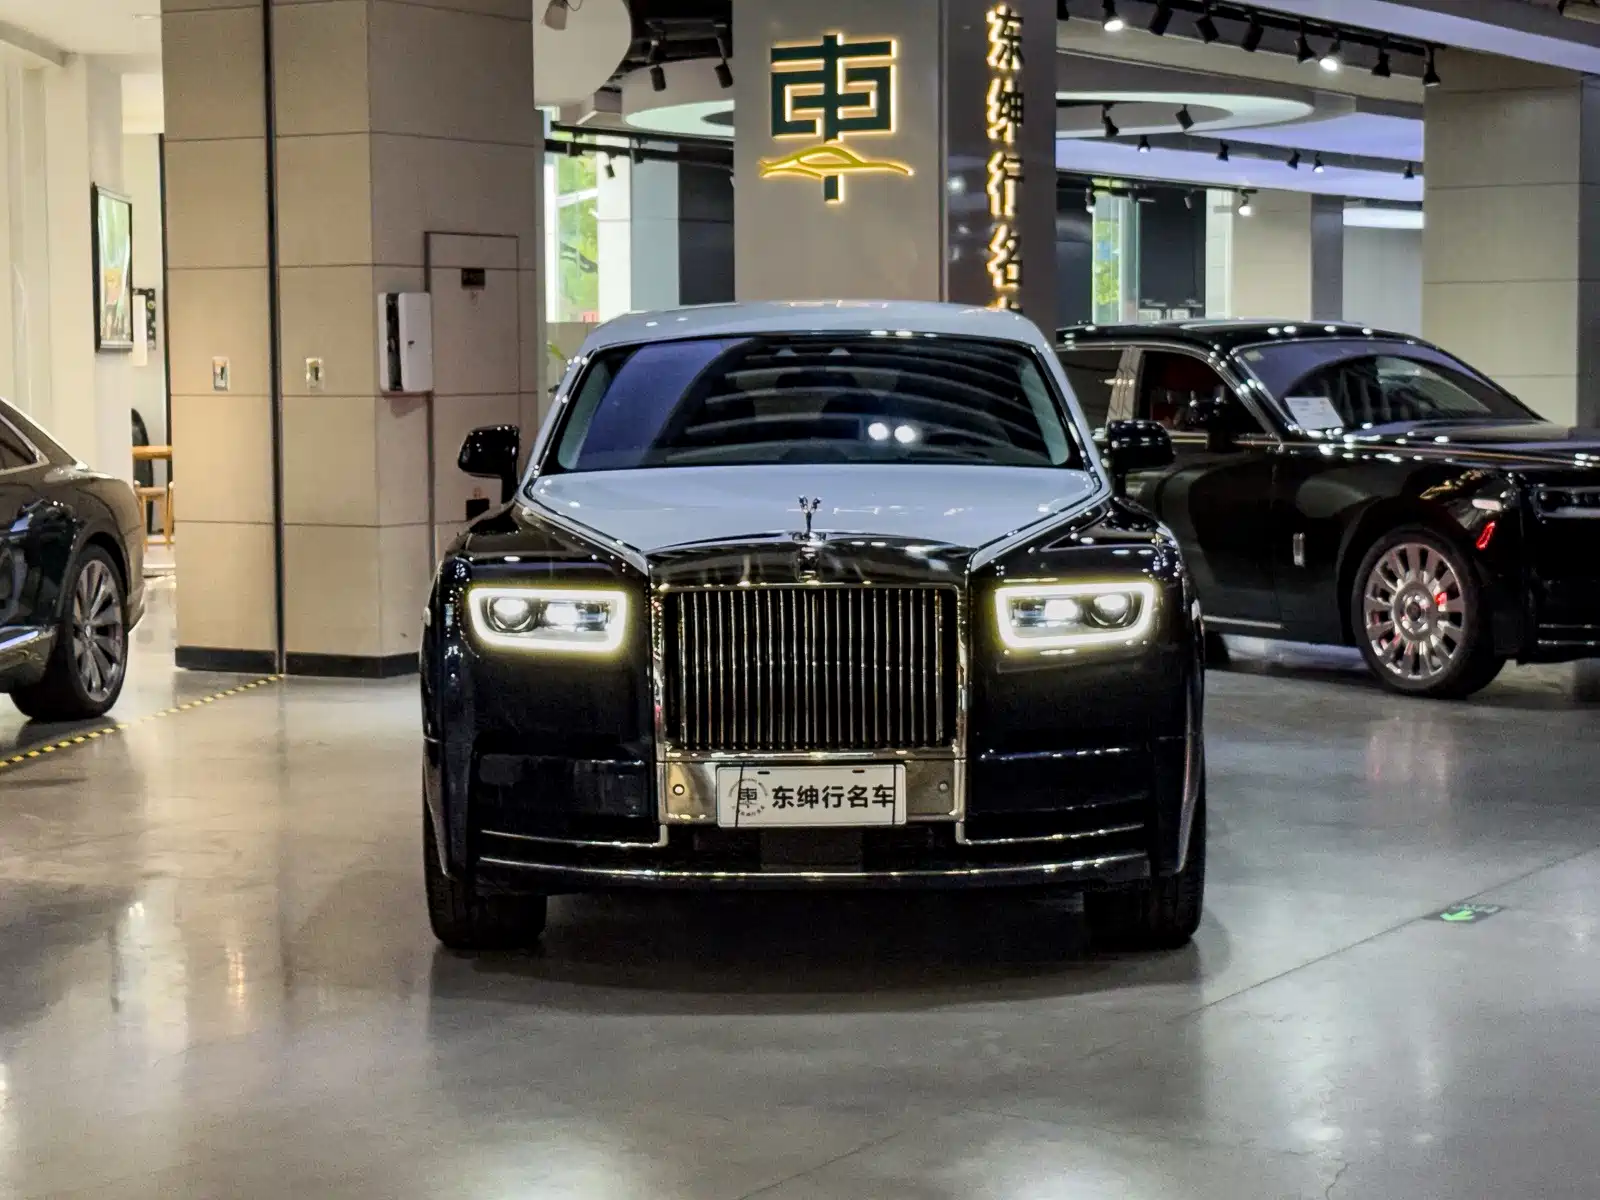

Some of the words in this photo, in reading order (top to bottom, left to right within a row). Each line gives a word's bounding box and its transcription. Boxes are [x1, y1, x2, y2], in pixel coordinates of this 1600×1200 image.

[771, 784, 895, 809] 东绅行名车
